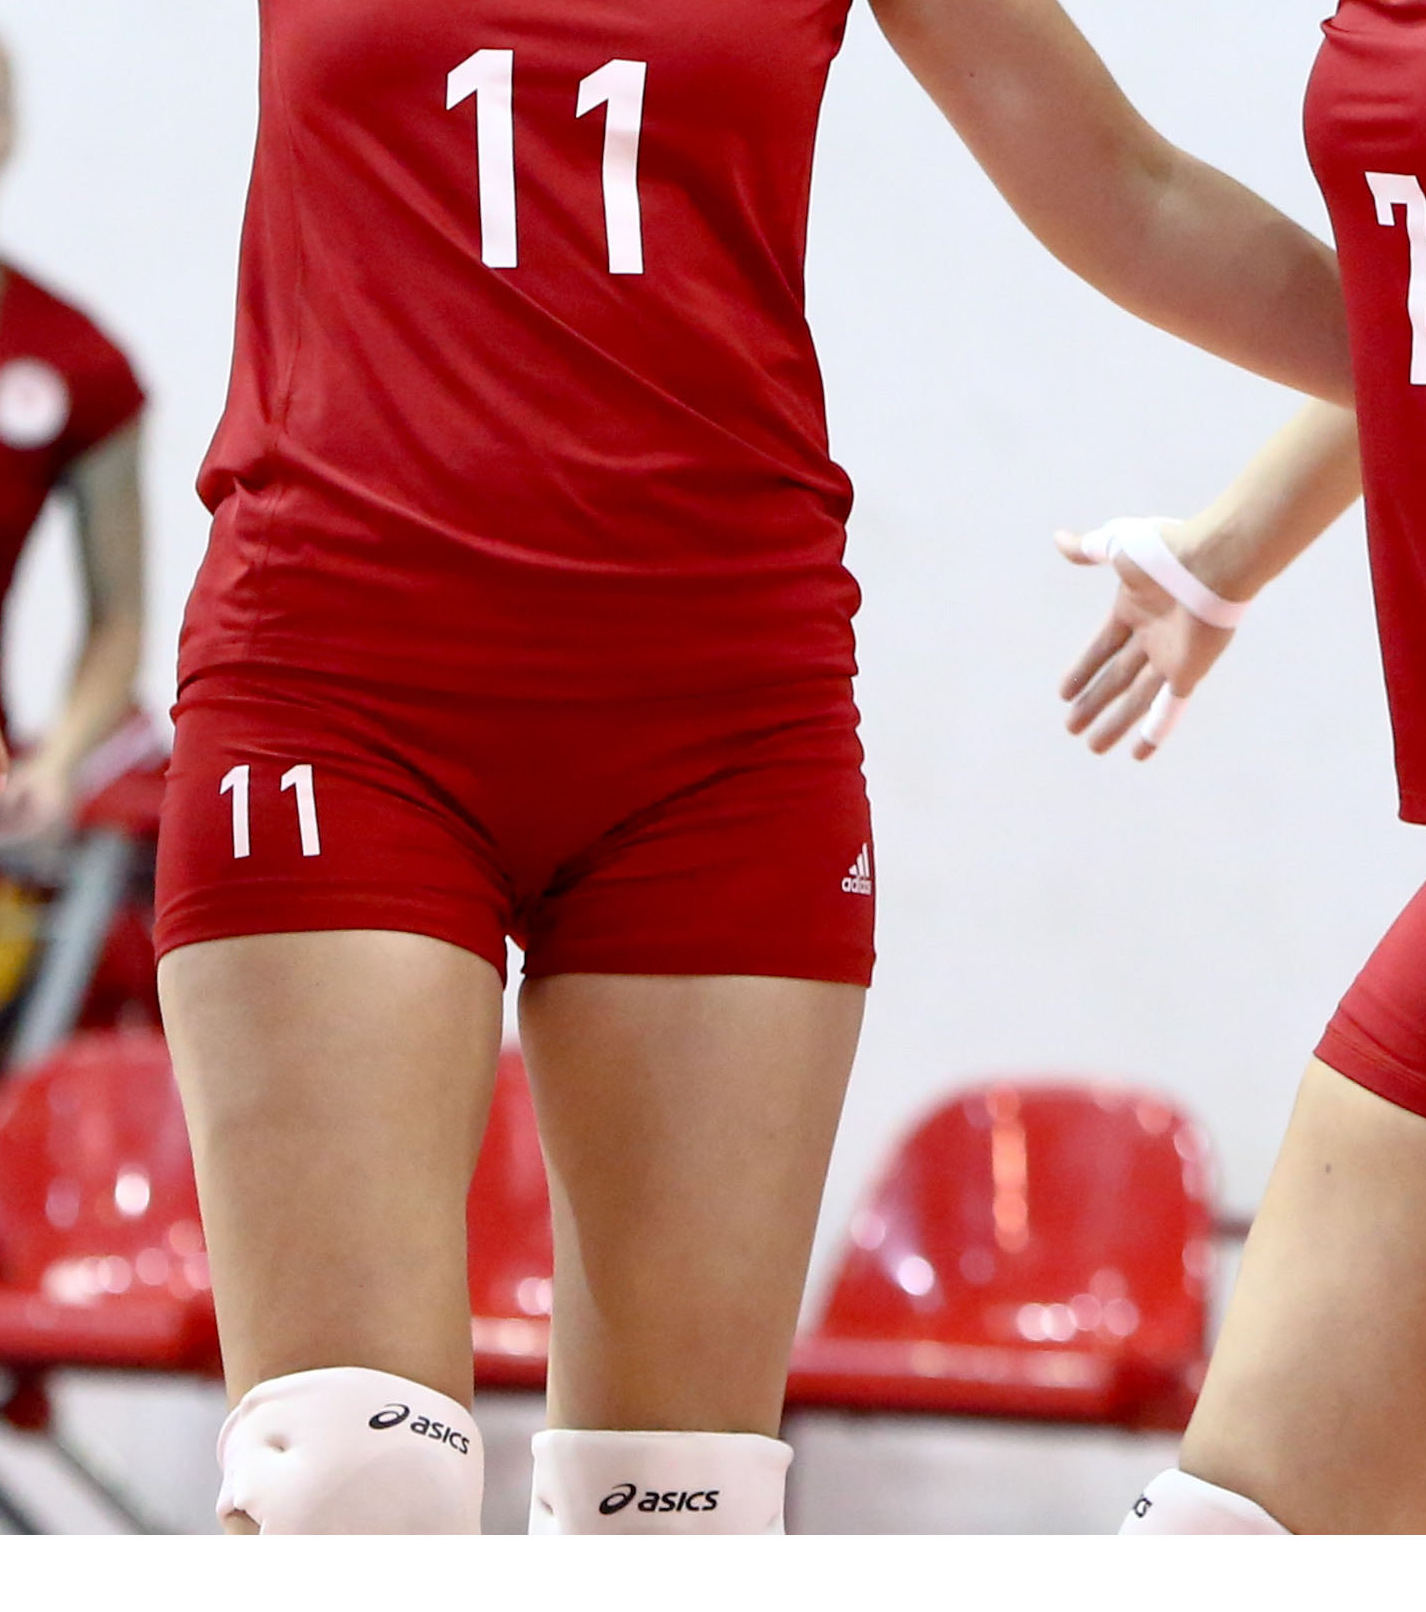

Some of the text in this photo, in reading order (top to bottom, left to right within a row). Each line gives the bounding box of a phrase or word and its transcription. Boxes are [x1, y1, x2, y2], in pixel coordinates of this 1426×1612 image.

[445, 48, 648, 275] 11
[219, 764, 321, 859] 11
[410, 1415, 470, 1455] asics
[637, 1490, 720, 1512] asics
